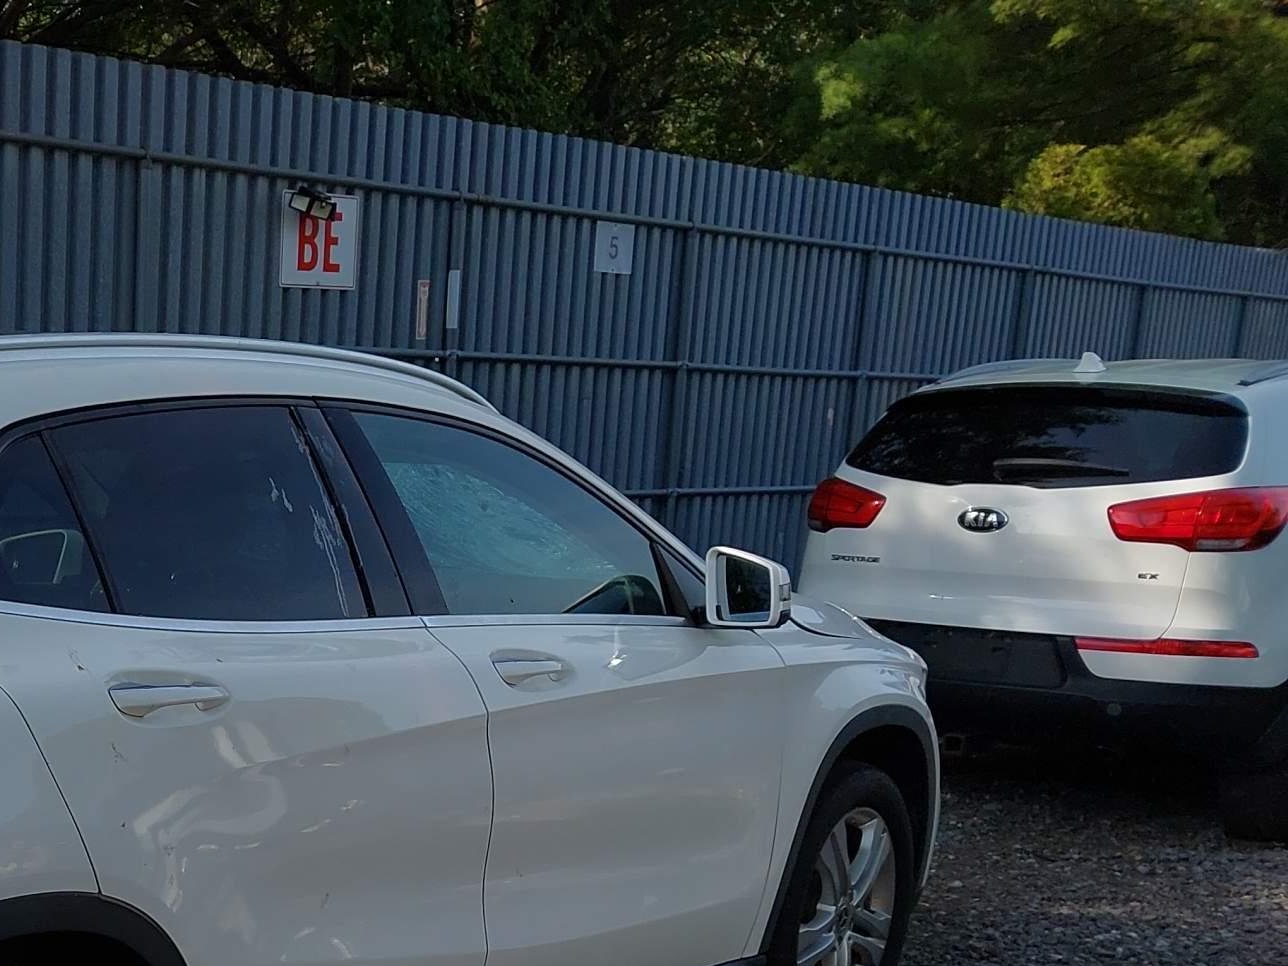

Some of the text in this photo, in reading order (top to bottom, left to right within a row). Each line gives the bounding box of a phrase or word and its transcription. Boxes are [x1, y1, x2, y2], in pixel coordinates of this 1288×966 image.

[296, 210, 343, 272] BE
[608, 235, 619, 260] 5
[964, 511, 999, 528] KIA
[831, 553, 881, 564] SPORTAGE
